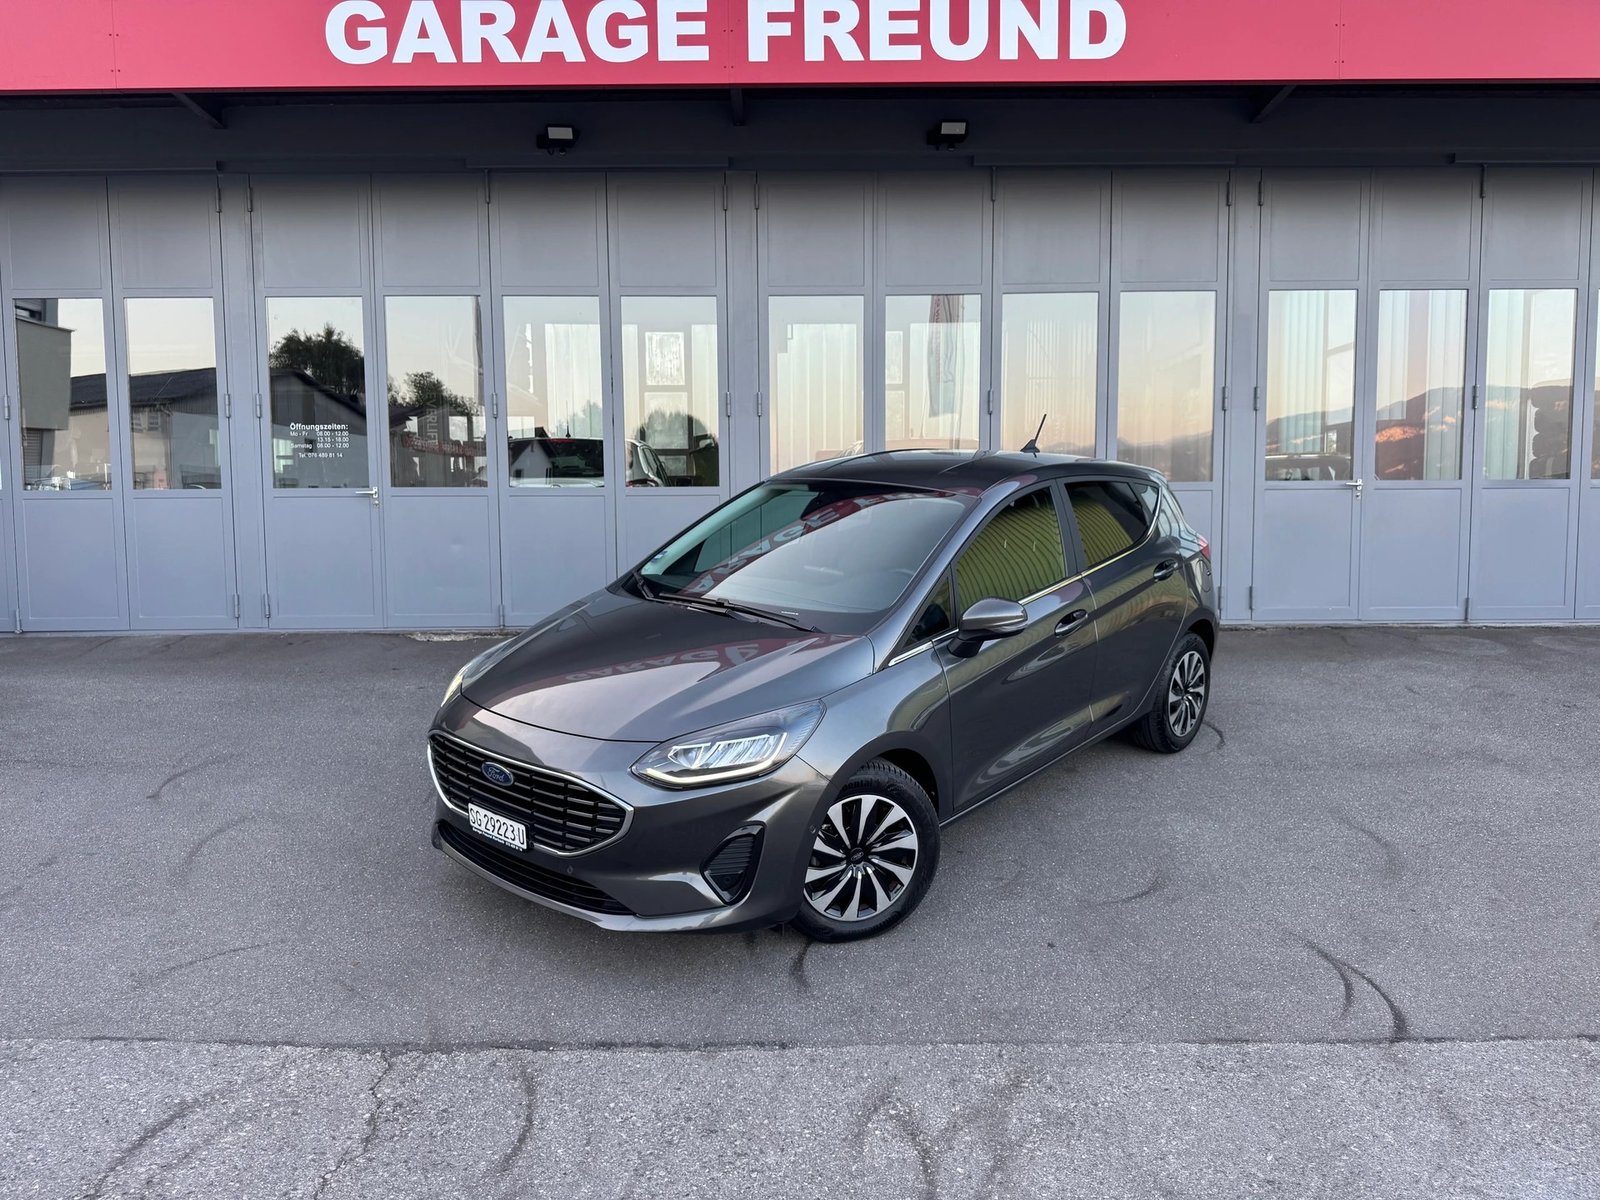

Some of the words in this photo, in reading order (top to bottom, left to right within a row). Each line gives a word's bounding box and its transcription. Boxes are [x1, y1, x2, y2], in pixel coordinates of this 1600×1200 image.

[325, 0, 710, 65] GARAGE
[747, 0, 1127, 62] FREUND
[289, 421, 349, 432] Öffnungszeiten:
[487, 766, 505, 782] Ford
[469, 807, 482, 827] SG
[483, 814, 516, 841] 29223
[517, 827, 525, 845] U
